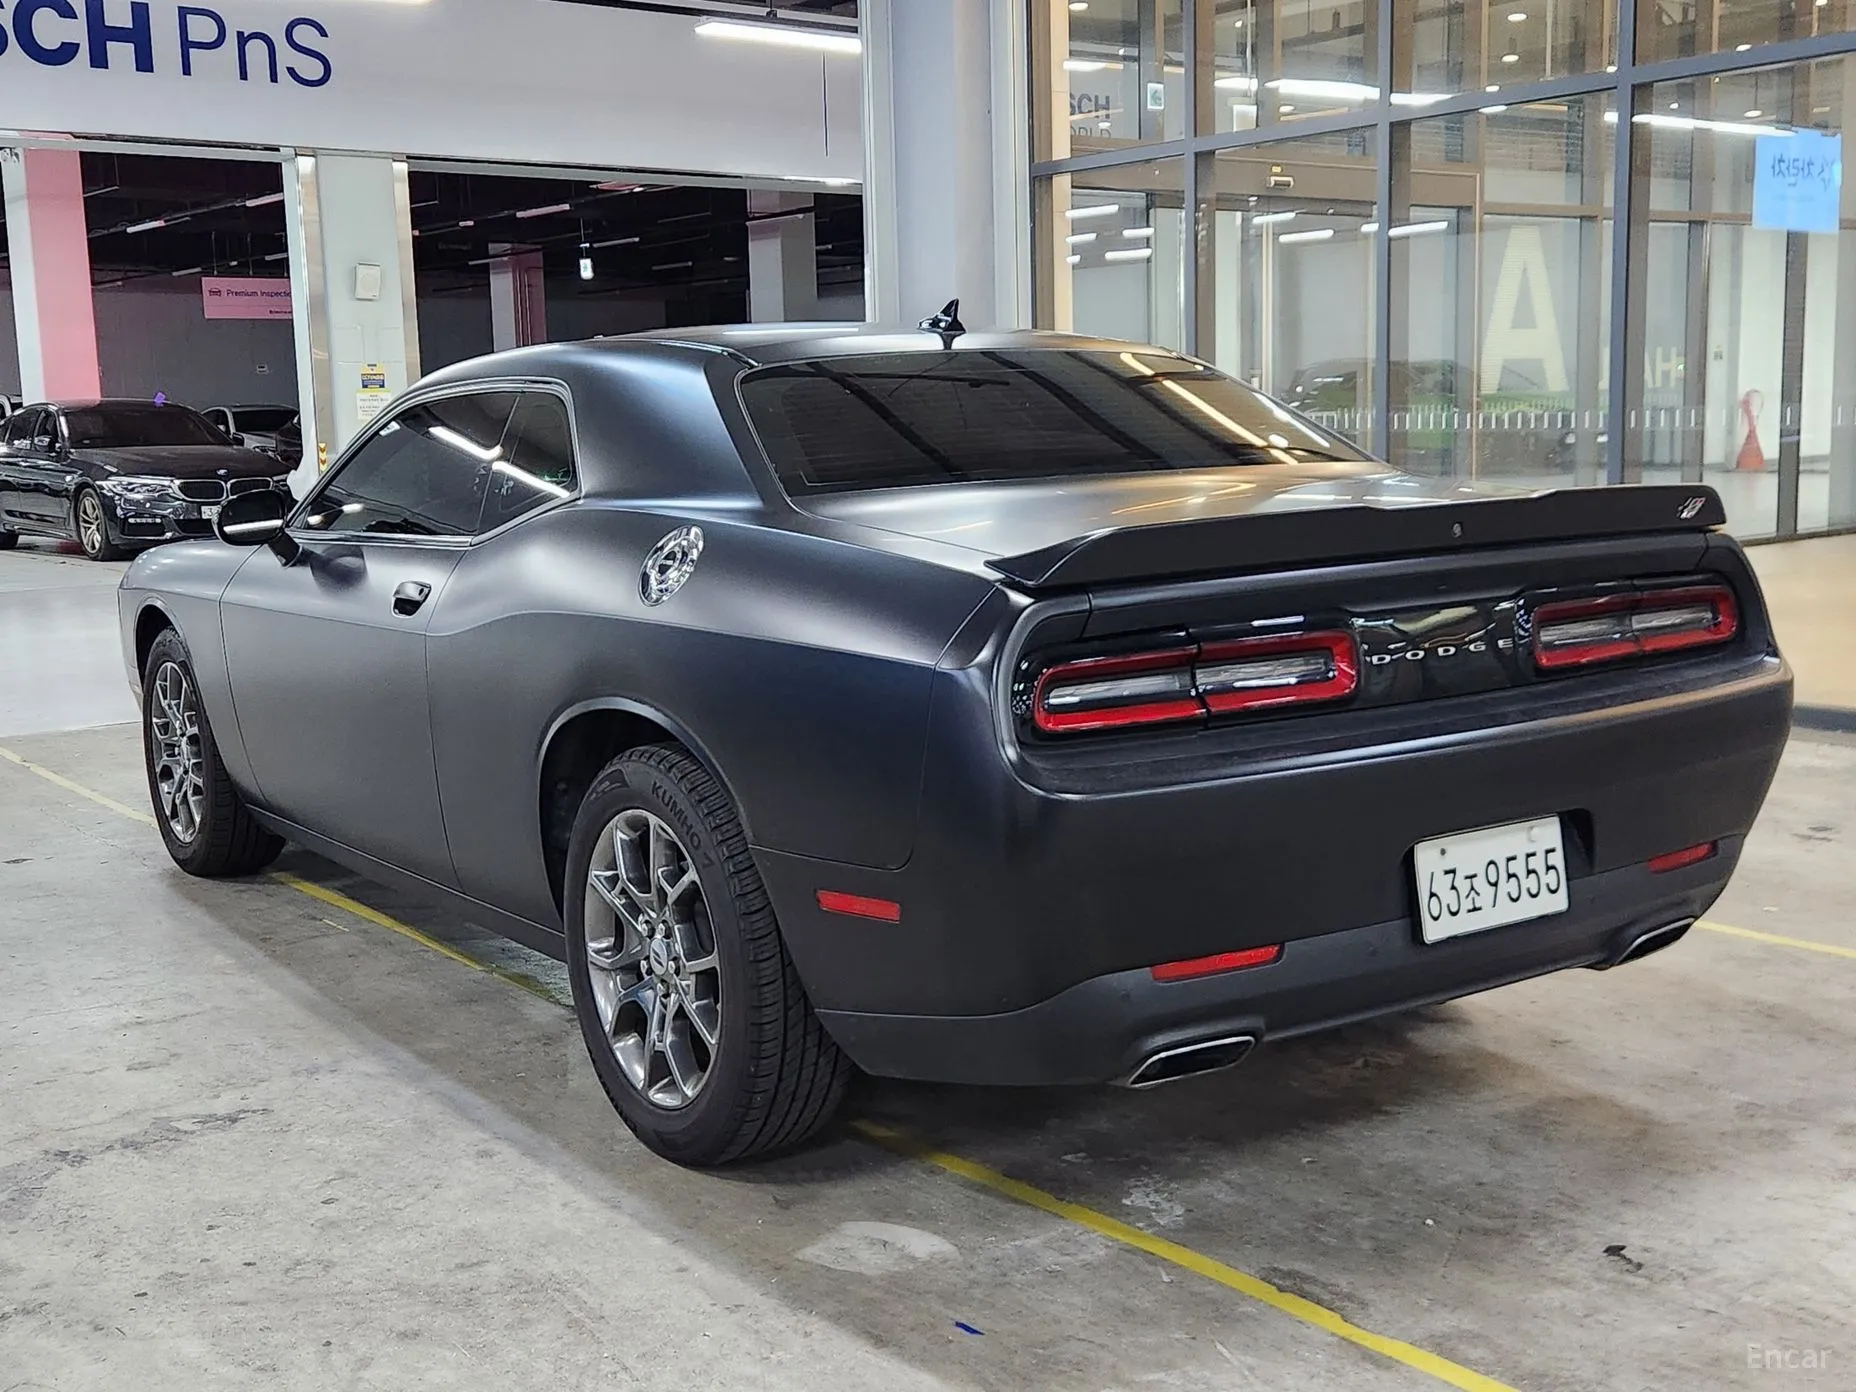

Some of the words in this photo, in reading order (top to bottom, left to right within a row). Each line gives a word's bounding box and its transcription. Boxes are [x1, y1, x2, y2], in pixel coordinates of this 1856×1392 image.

[0, 0, 154, 73] CH
[177, 6, 332, 87] PnS
[226, 289, 258, 297] Premium
[1480, 225, 1570, 393] A
[1371, 638, 1513, 665] DODGE
[651, 779, 701, 850] KUMHO
[1427, 847, 1561, 922] 63조9555
